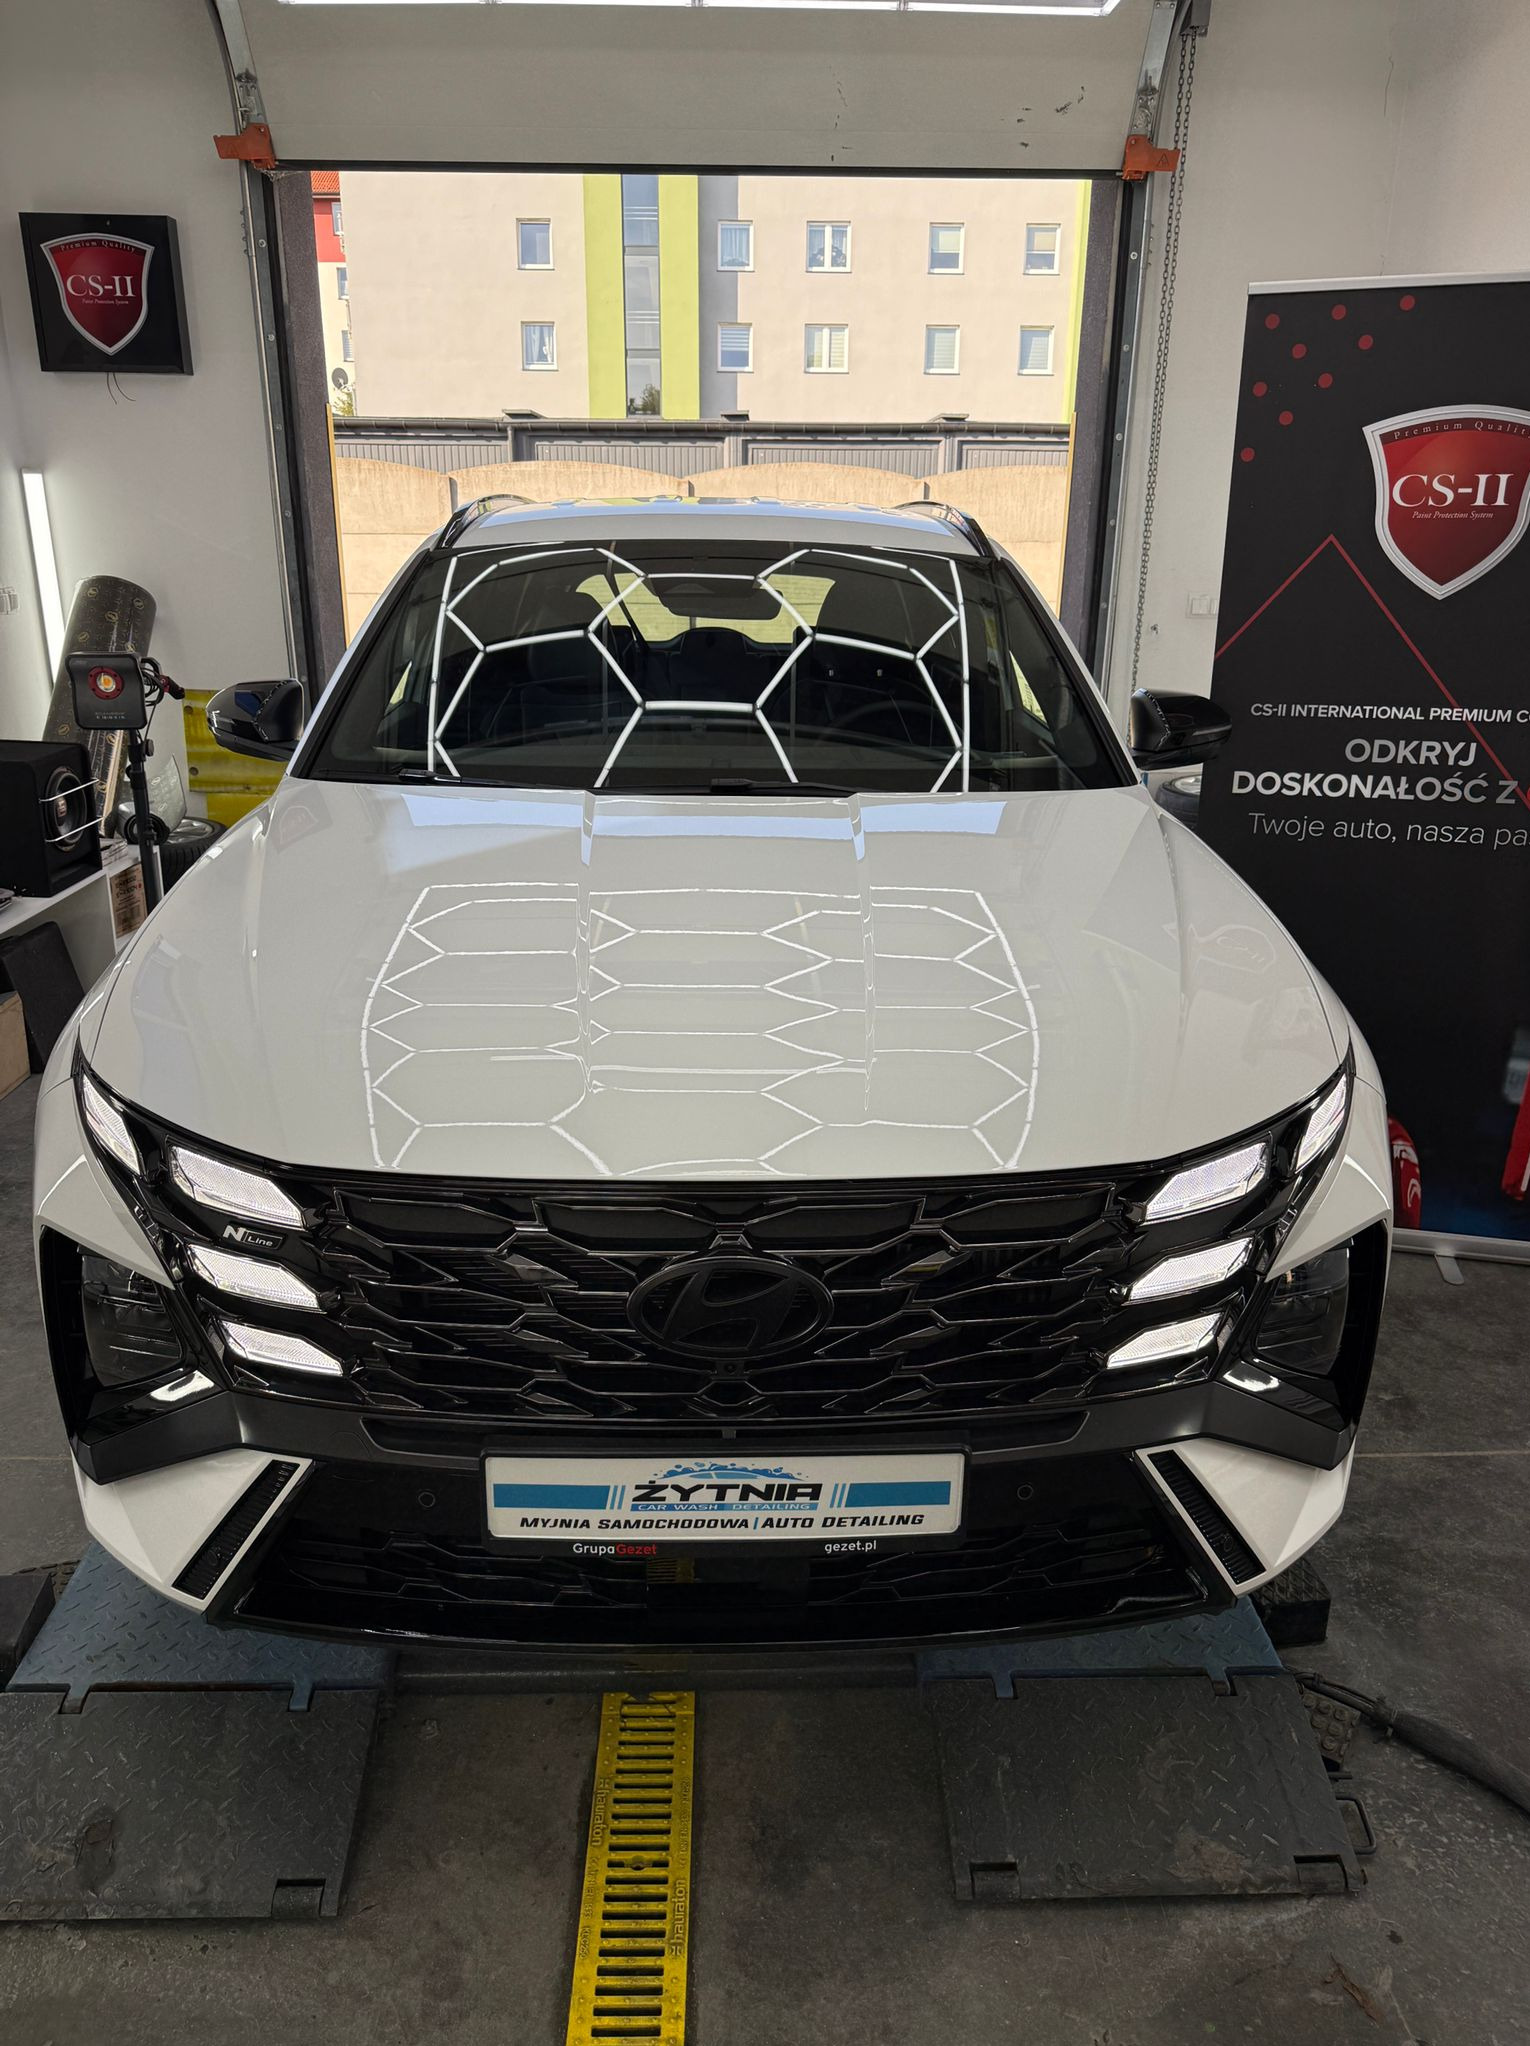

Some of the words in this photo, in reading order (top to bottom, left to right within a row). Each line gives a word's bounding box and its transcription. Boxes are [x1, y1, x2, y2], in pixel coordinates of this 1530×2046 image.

[61, 242, 97, 251] Premium
[102, 240, 136, 253] Quality
[66, 274, 136, 297] CS-II
[1393, 422, 1463, 440] Premium
[1474, 420, 1530, 439] Qualit
[1392, 473, 1514, 508] CS-II
[1412, 511, 1432, 519] Paint
[1433, 511, 1468, 519] Protection
[1470, 510, 1494, 520] System
[1250, 703, 1287, 717] CS-II
[1290, 704, 1425, 720] INTERNATIONAL
[1429, 707, 1512, 723] PREMIUM
[1345, 738, 1477, 767] ODKRYJ
[1232, 770, 1489, 803] DOSKONAŁOŚĆ
[1496, 780, 1519, 804] Z
[1248, 812, 1325, 841] Twoje
[1333, 818, 1397, 843] auto,
[1406, 823, 1485, 845] nasza
[1493, 828, 1530, 850] pa
[248, 1235, 273, 1247] Line
[632, 1480, 823, 1502] ŻYTNIA
[520, 1517, 591, 1529] MYJNIA
[598, 1518, 749, 1530] SAMOCHODOWA
[761, 1517, 814, 1529] AUTO
[821, 1514, 925, 1528] DETAILING
[824, 1540, 877, 1553] gezet.pl
[591, 1788, 608, 1846] hauraton
[670, 1879, 687, 1944] hauraton
